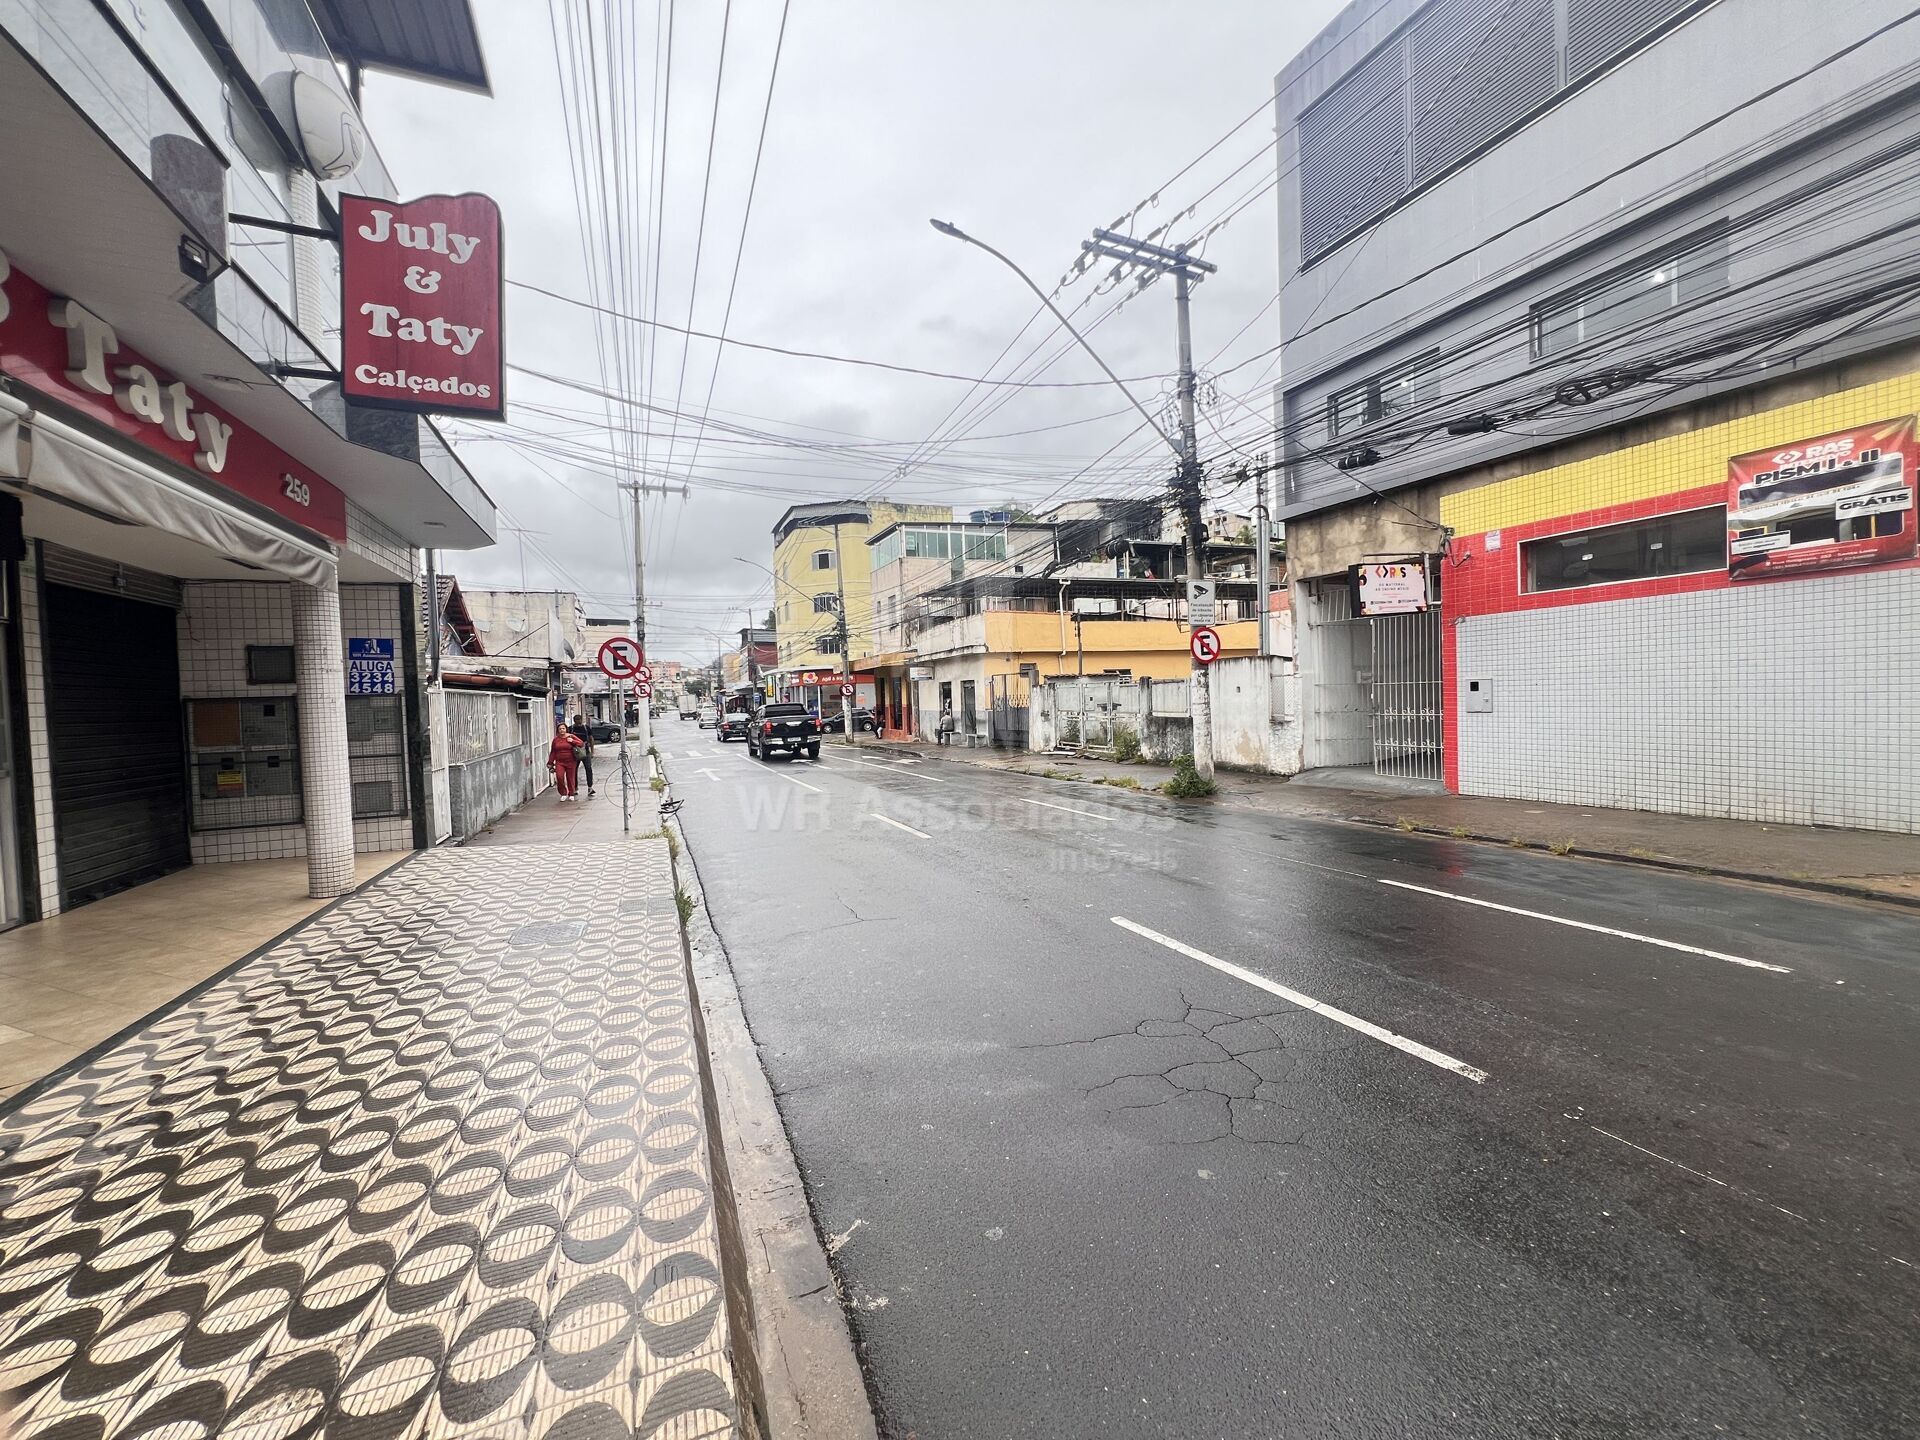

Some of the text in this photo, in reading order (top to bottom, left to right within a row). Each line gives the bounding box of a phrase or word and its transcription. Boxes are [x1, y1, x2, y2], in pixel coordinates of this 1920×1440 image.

[358, 209, 481, 265] July
[403, 265, 442, 294] &
[360, 302, 484, 356] Taty
[52, 299, 233, 473] Taty
[355, 364, 491, 398] Calçados
[1805, 438, 1855, 459] RAS
[1755, 461, 1821, 485] PISM
[1860, 448, 1879, 463] II
[283, 472, 311, 507] 259
[1838, 492, 1910, 511] GRÁTIS
[350, 660, 393, 672] ALUGA
[350, 672, 394, 683] 3234
[350, 683, 394, 694] 4548
